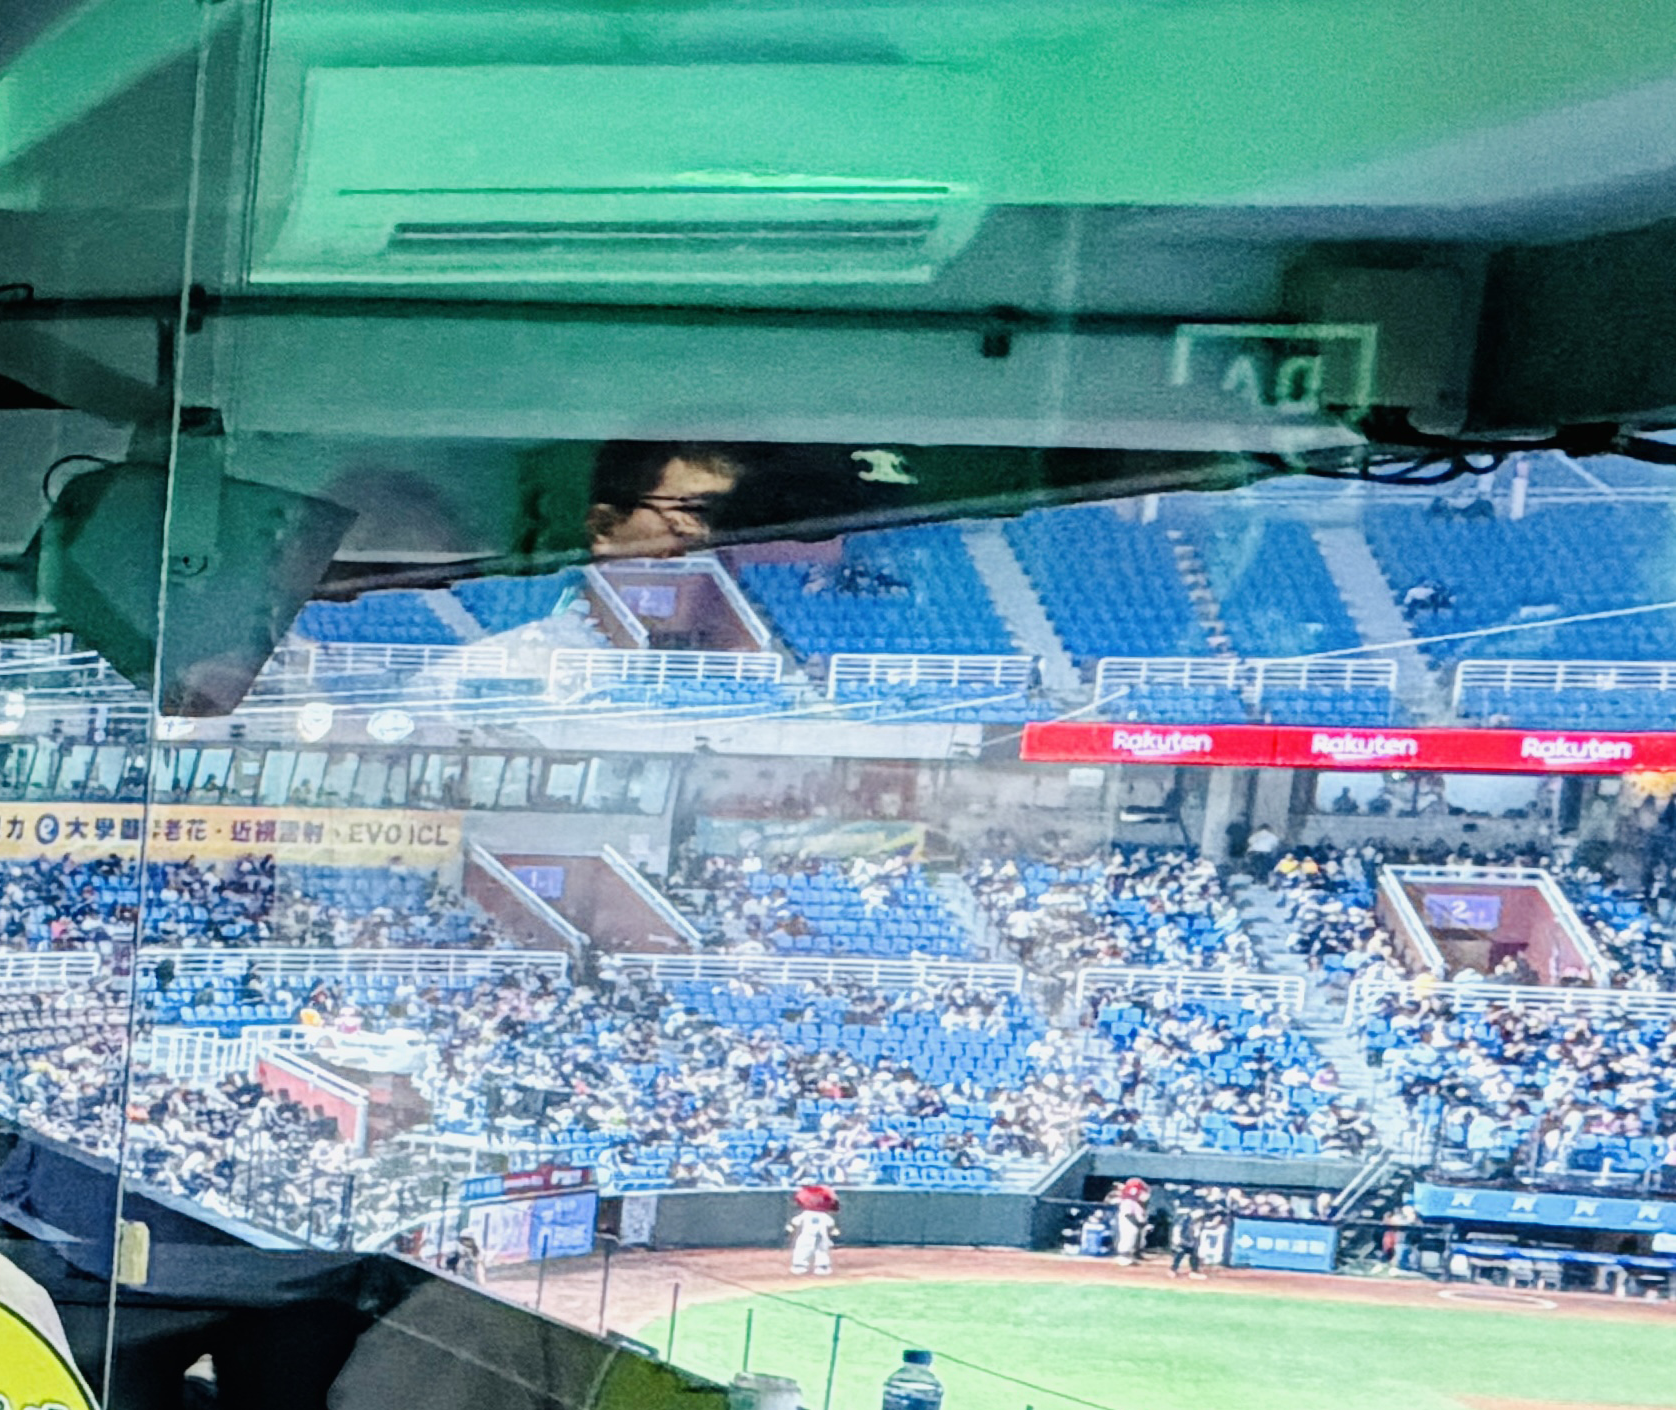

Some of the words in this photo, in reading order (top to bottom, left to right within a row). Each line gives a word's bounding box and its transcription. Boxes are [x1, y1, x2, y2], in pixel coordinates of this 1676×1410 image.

[1112, 729, 1212, 755] Rakuten
[1311, 731, 1418, 759] Rakuten
[1521, 735, 1632, 763] Rakuten
